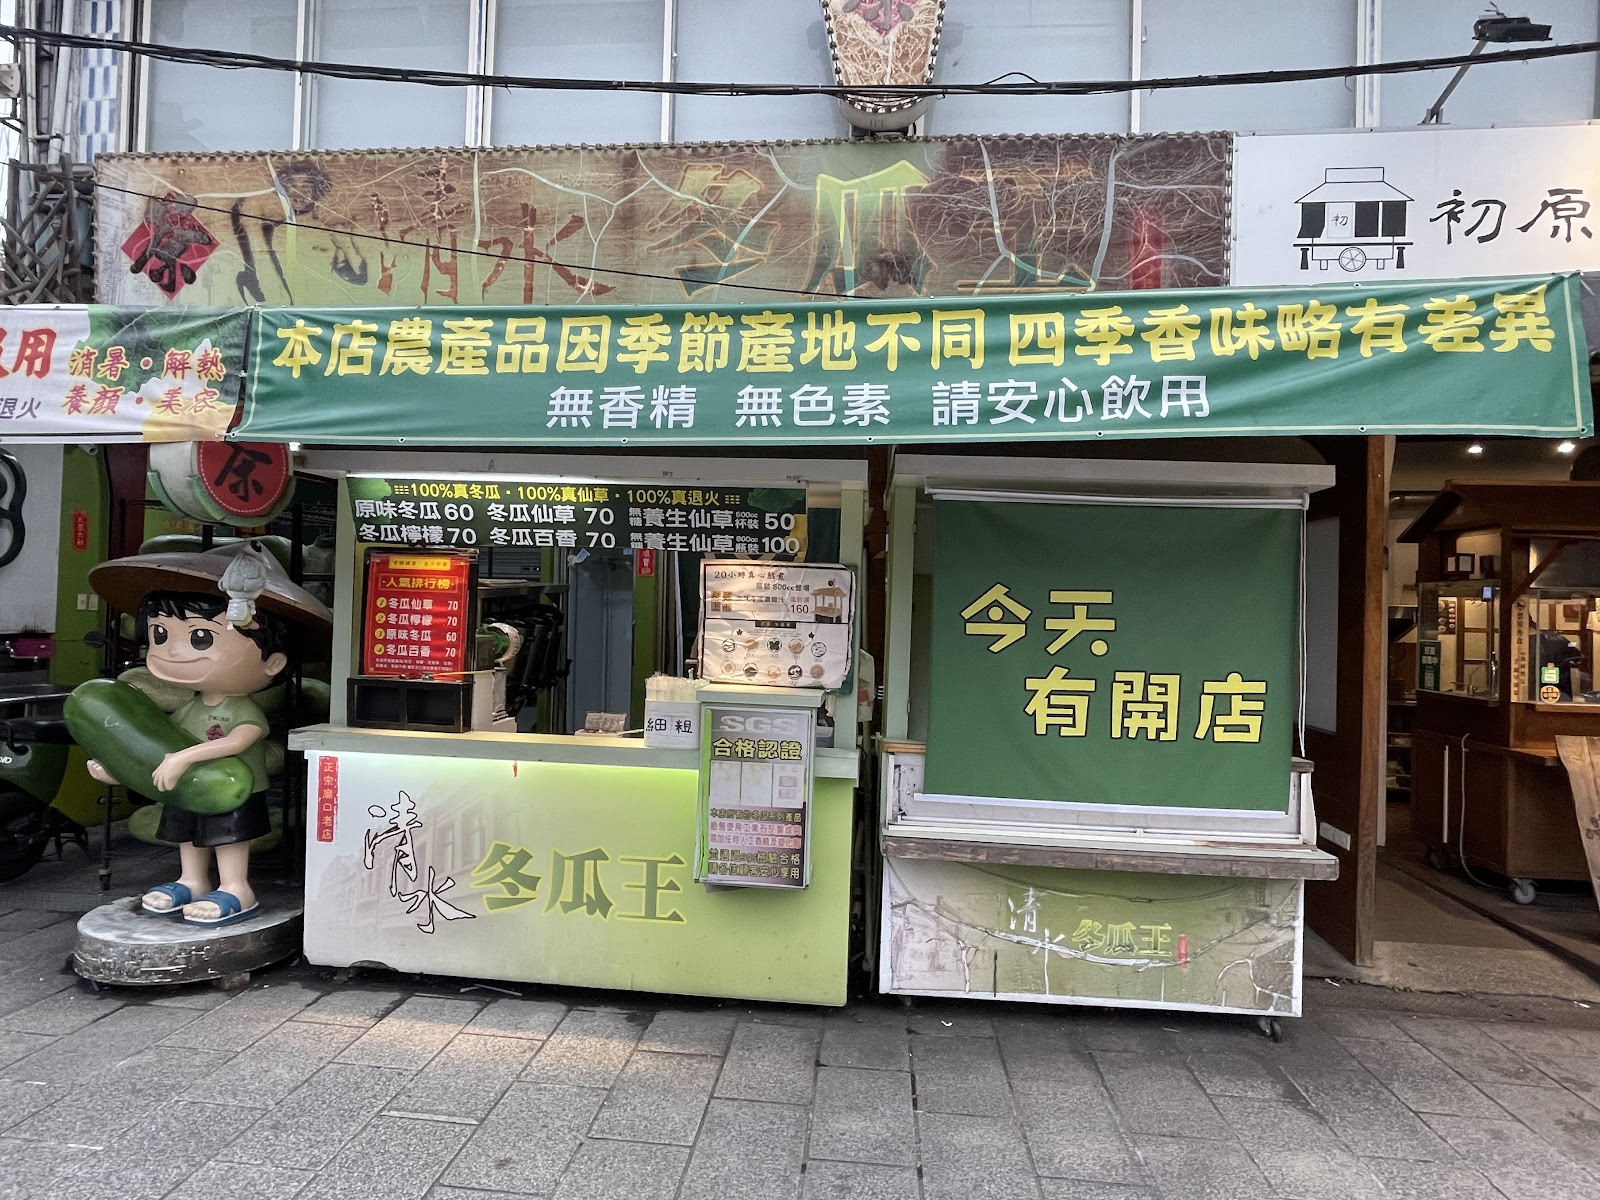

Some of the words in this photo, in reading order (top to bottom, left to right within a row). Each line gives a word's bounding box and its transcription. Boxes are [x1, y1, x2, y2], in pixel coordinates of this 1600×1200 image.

[1331, 213, 1349, 226] 初
[1429, 188, 1593, 245] 初原
[272, 308, 986, 379] 本店農產品因季節產地不同
[1008, 285, 1556, 368] 四季香味略有差異
[546, 384, 697, 429] 無香精
[735, 382, 892, 428] 無色素
[931, 374, 1211, 426] 請安心飲用
[355, 499, 441, 519] 原味冬瓜
[444, 503, 474, 521] 60
[486, 503, 576, 525] 冬瓜仙草
[583, 507, 615, 525] 70
[642, 507, 734, 530] 養生仙草
[764, 512, 795, 531] 50
[359, 523, 444, 544] 冬瓜檸檬
[446, 528, 477, 544] 70
[489, 526, 578, 548] 冬瓜百香
[585, 531, 616, 548] 70
[643, 531, 735, 553] 養生仙草
[761, 535, 801, 554] 100
[385, 576, 451, 590] 人氣排行榜
[388, 597, 433, 610] 冬瓜仙草
[447, 600, 459, 611] 70
[790, 604, 809, 614] 160
[387, 613, 433, 626] 冬瓜檸檬
[446, 616, 458, 626] 70
[960, 583, 1116, 656] 今天
[386, 628, 432, 641] 原味冬瓜
[446, 632, 457, 642] 60
[386, 644, 431, 657] 冬瓜百香
[445, 647, 456, 657] 70
[1025, 666, 1267, 743] 有開店
[645, 718, 667, 732] 細
[719, 715, 798, 734] SGS
[712, 737, 802, 760] 合格認證
[364, 790, 477, 934] 清水
[470, 840, 688, 924] 冬瓜王
[1072, 918, 1173, 957] 冬瓜王
